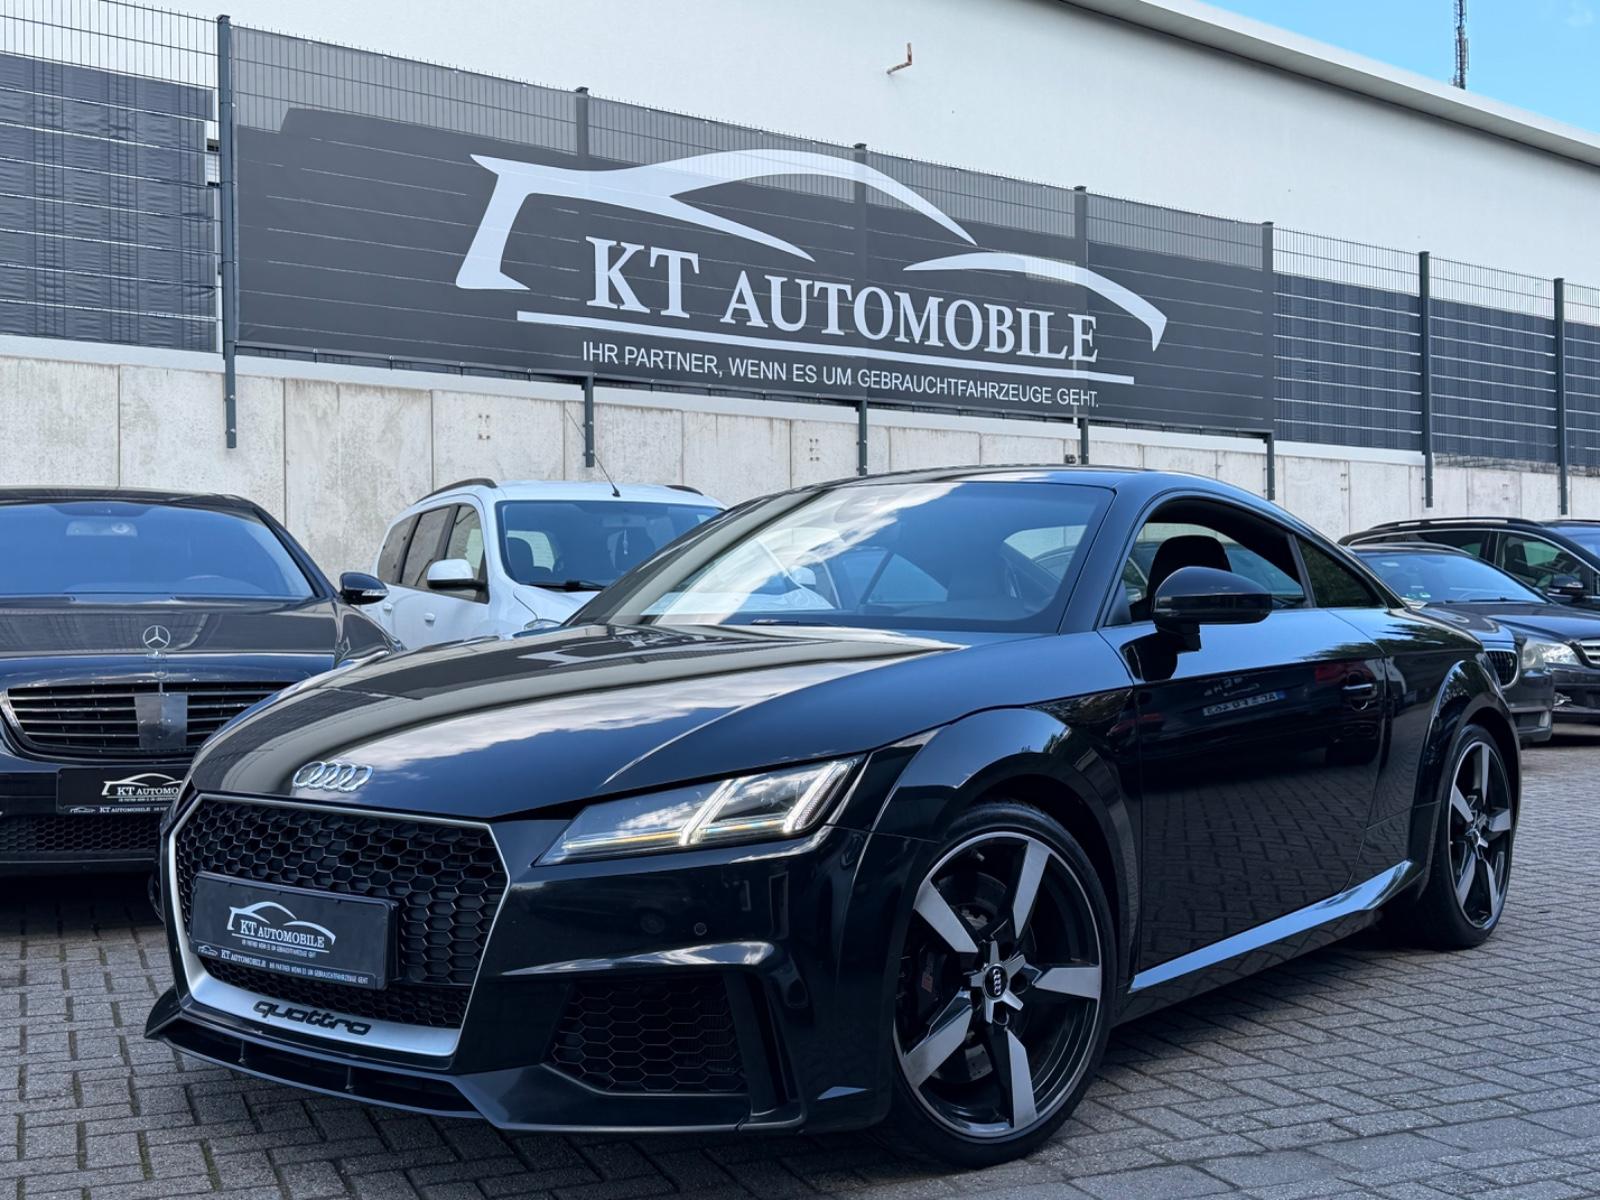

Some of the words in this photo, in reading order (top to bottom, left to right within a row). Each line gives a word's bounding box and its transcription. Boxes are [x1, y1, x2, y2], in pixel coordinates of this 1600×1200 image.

[586, 236, 699, 319] KT
[720, 270, 1098, 363] AUTOMOBILE
[583, 341, 618, 364] IHR
[624, 346, 723, 378] PARTNER,
[728, 357, 787, 381] WENN
[792, 364, 817, 384] ES
[823, 367, 852, 386] UM
[857, 369, 1052, 404] GEBRAUCHTFAHRZEUGE
[1056, 388, 1099, 408] GEHT.
[117, 787, 134, 796] KT
[136, 787, 179, 795] AUTOMO
[240, 919, 258, 936] KT
[258, 928, 325, 949] AUTOMOBILE
[221, 949, 230, 959] KT
[253, 1000, 372, 1036] quattro
